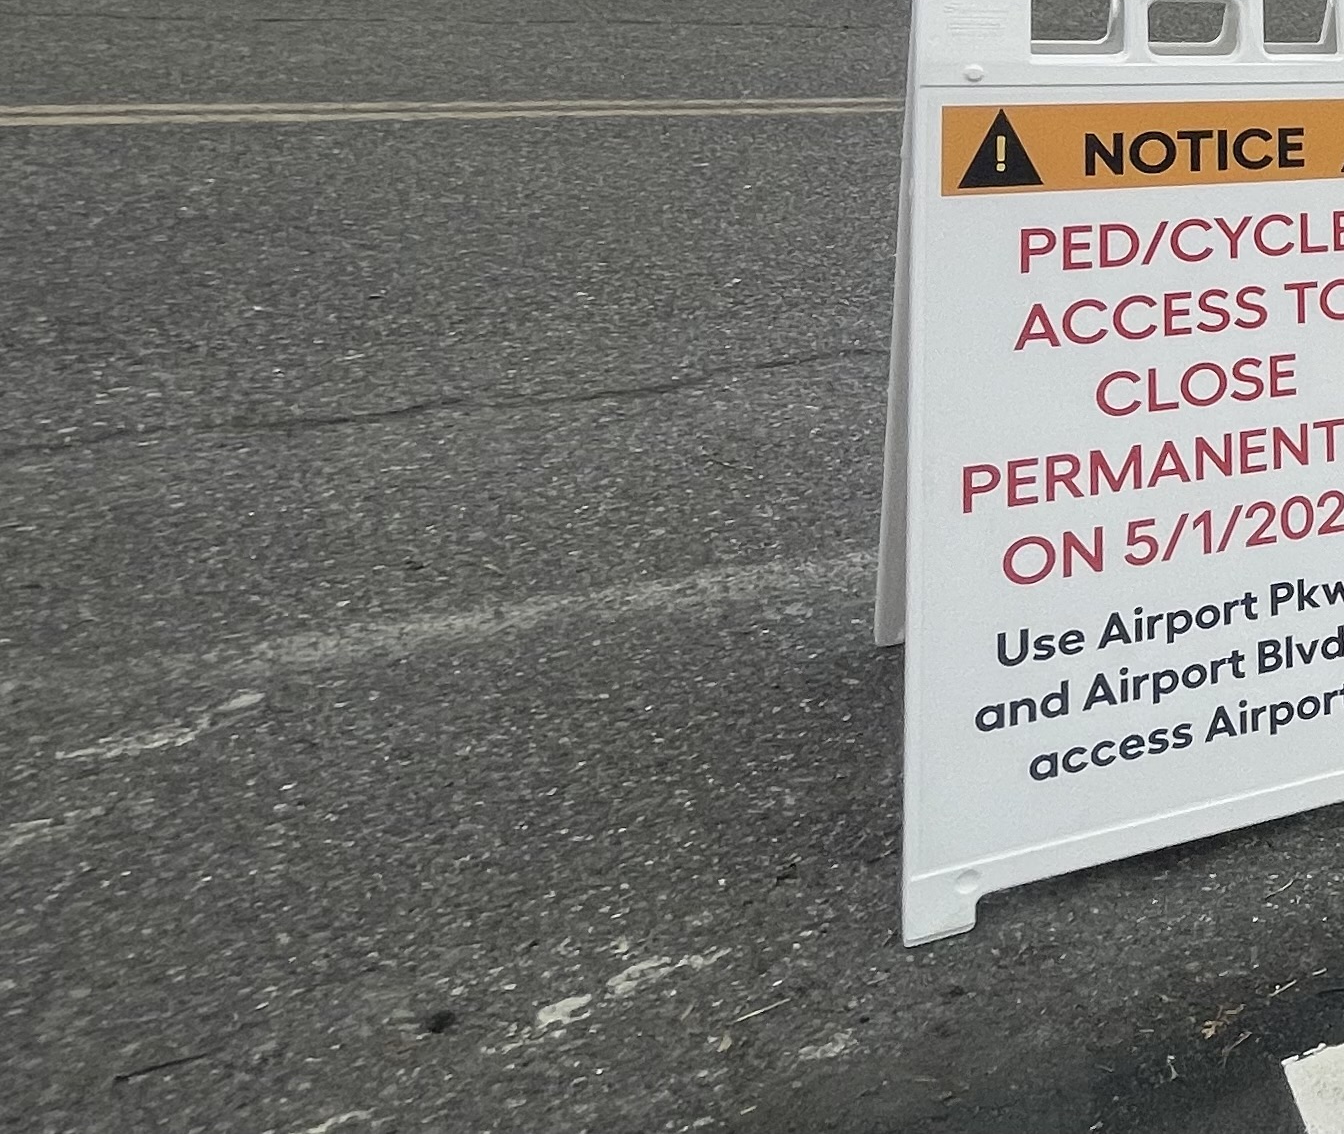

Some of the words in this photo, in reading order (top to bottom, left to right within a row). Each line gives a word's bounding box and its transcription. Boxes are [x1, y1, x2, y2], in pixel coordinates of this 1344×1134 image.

[1084, 128, 1305, 176] NOTICE
[1013, 286, 1269, 350] ACCESS
[1096, 354, 1297, 417] CLOSE
[1002, 526, 1103, 585] ON
[997, 625, 1085, 666] Use
[1098, 591, 1259, 651] Airport
[975, 681, 1069, 733] and
[1083, 647, 1246, 712] Airport
[1257, 625, 1344, 674] Blvd
[1029, 724, 1193, 782] access
